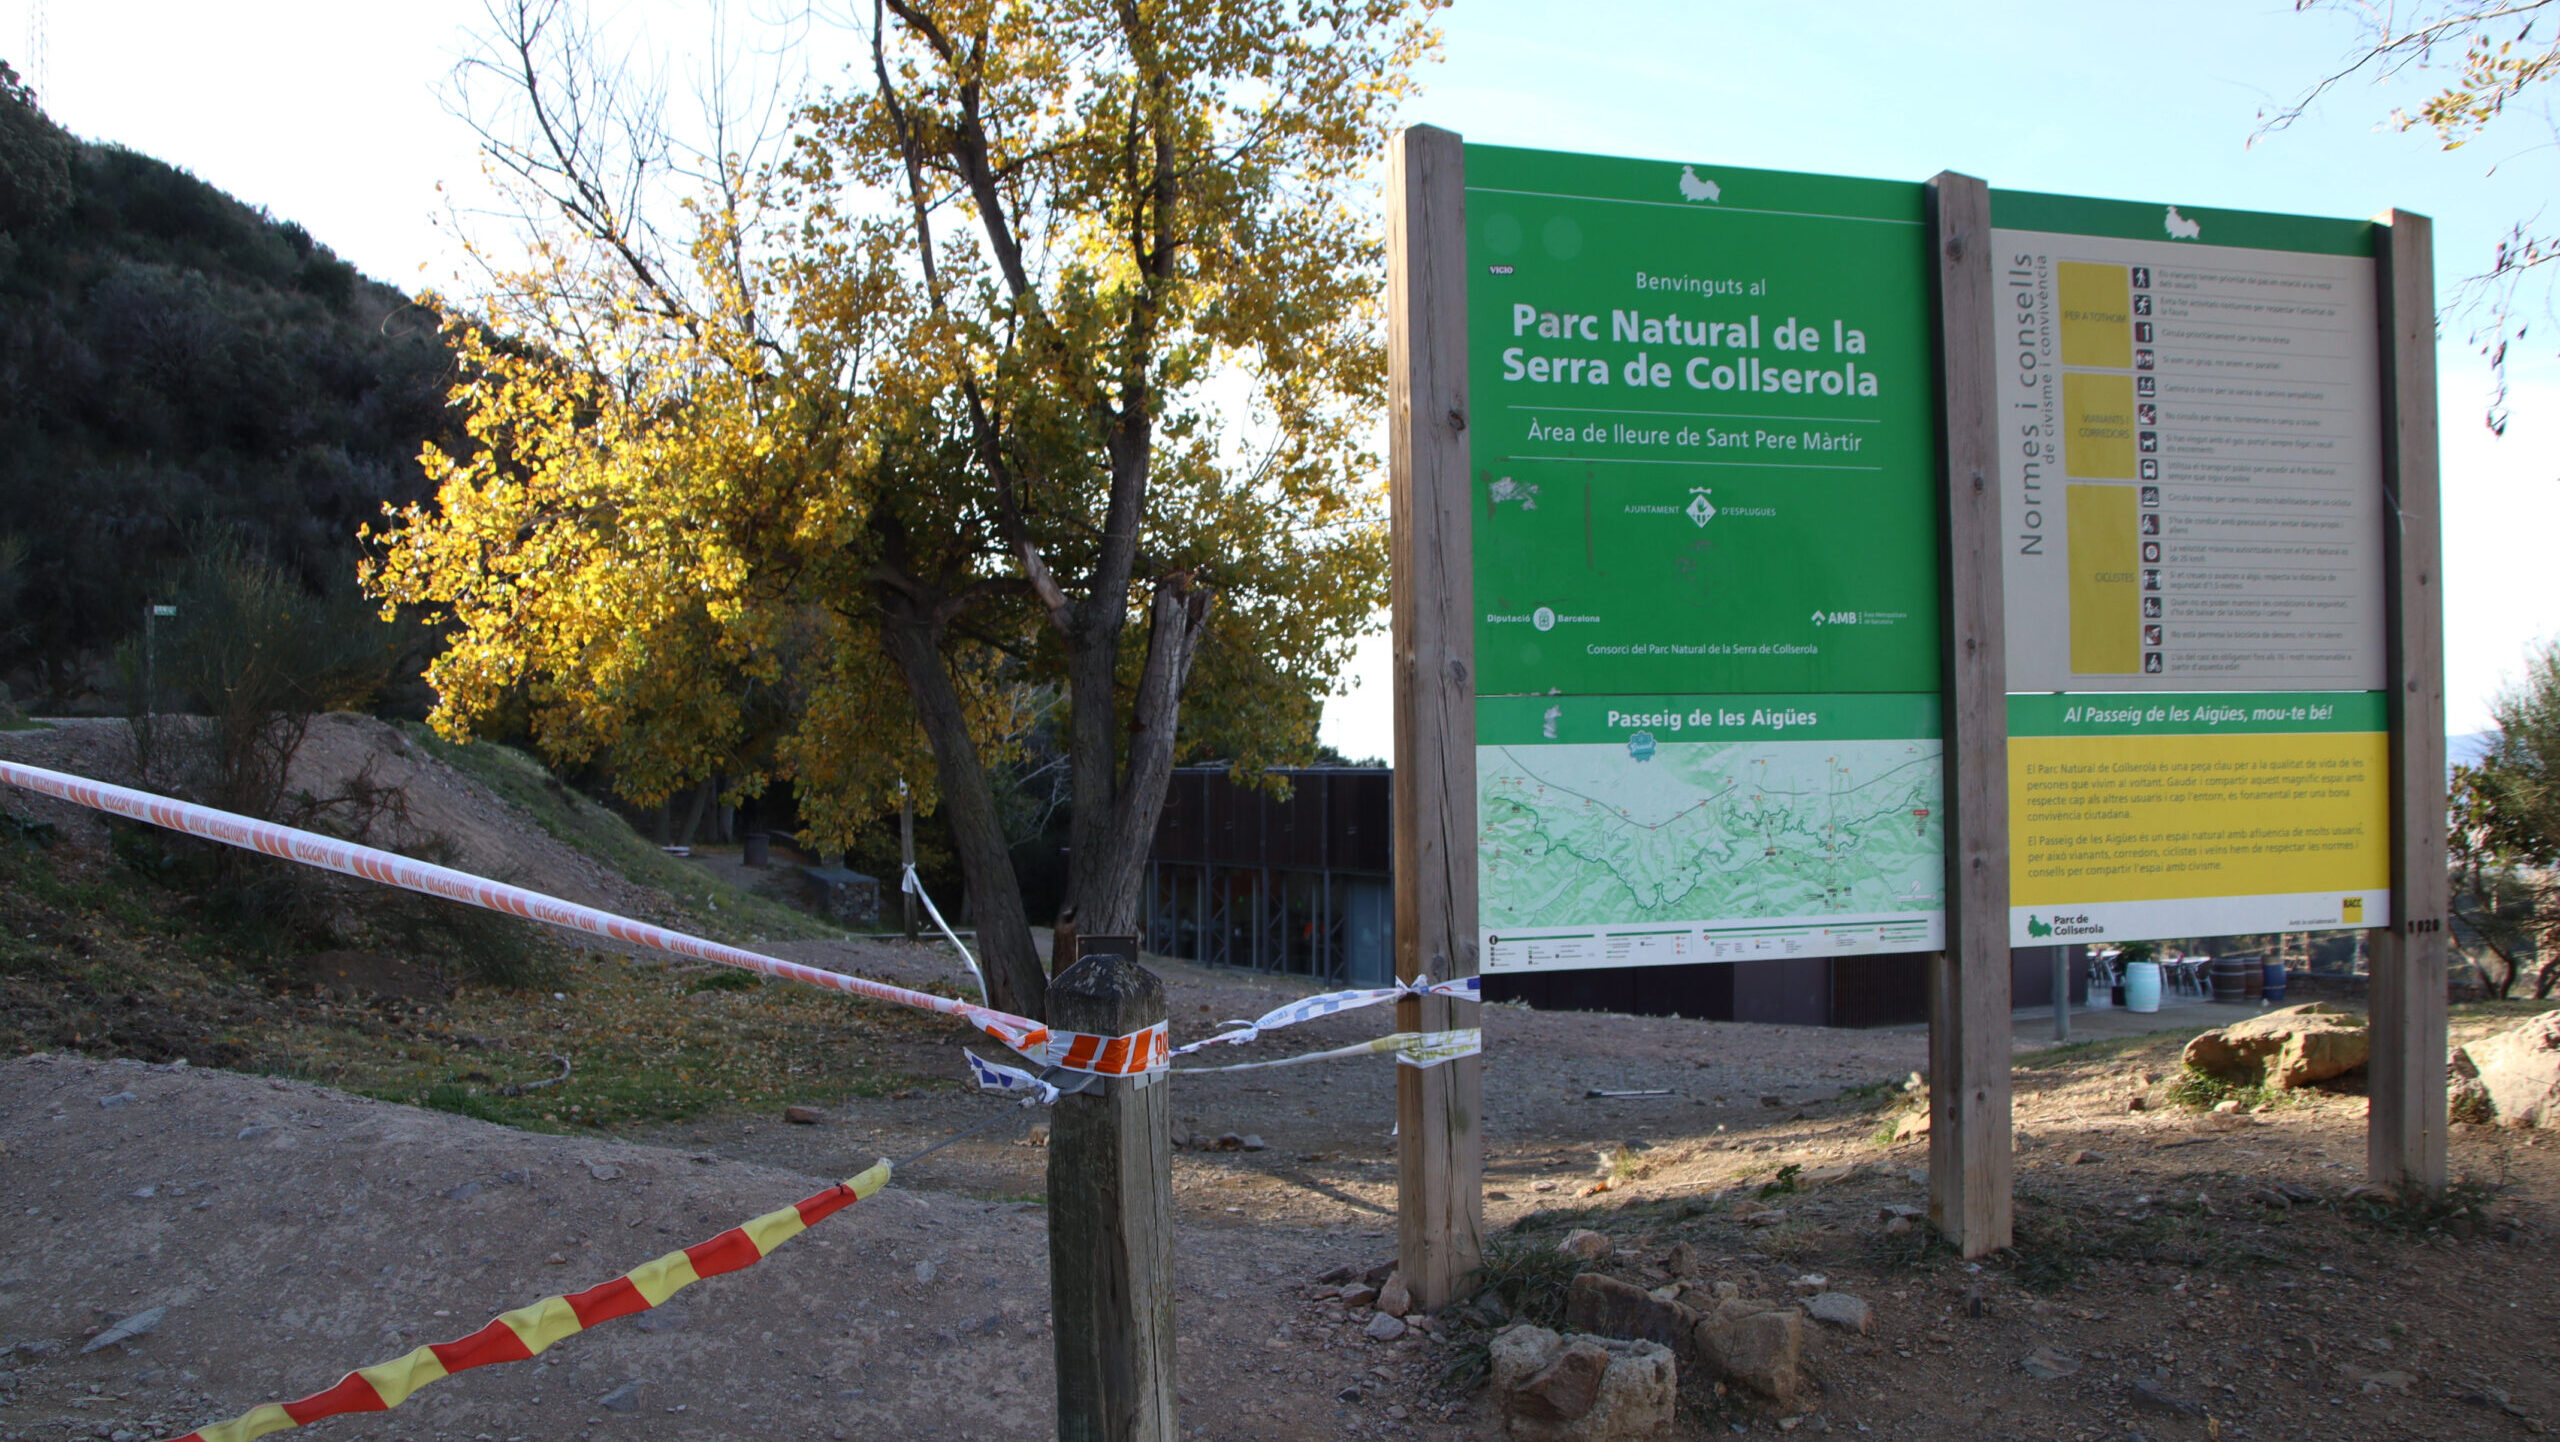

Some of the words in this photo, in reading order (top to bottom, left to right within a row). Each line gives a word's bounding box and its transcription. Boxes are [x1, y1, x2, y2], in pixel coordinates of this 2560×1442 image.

[1489, 265, 1514, 275] VICIO
[1636, 271, 1743, 297] Benvinguts
[1750, 279, 1766, 296] al
[2035, 255, 2052, 355] convivència
[1513, 304, 1598, 340] Parc
[1612, 309, 1759, 349] Natural
[1773, 318, 1820, 352] de
[1835, 320, 1866, 354] la
[2009, 253, 2037, 388] consells
[1502, 347, 1609, 385] Serra
[1624, 352, 1672, 388] de
[1686, 357, 1878, 396] Collserola
[2015, 402, 2038, 410] i
[2041, 374, 2055, 436] civisme
[1528, 417, 1575, 443] Àrea
[1582, 423, 1607, 442] de
[1613, 424, 1670, 444] lleure
[1676, 427, 1700, 446] de
[1706, 429, 1750, 448] Sant
[1756, 430, 1797, 449] Pere
[1803, 431, 1862, 451] Màrtir
[2042, 440, 2055, 465] de
[2020, 425, 2043, 555] Normes
[1624, 505, 1680, 514] AJUNTAMENT
[1722, 507, 1776, 517] D'ESPLUGUES
[1487, 613, 1530, 624] Diputació
[1557, 614, 1600, 622] Barcelona
[1828, 612, 1857, 624] AMB
[1587, 644, 1630, 654] Consorci
[1632, 644, 1647, 654] del
[1649, 644, 1669, 654] Parc
[1671, 644, 1706, 654] Natural
[1708, 644, 1720, 654] de
[1723, 644, 1731, 654] la
[1733, 644, 1757, 654] Serra
[1759, 644, 1771, 654] de
[1773, 644, 1818, 654] Collserola
[1608, 711, 1681, 731] Passeig
[1688, 710, 1712, 726] de
[1718, 709, 1745, 726] les
[1752, 708, 1817, 729] Aigües
[2064, 707, 2082, 723] Al
[2085, 707, 2143, 727] Passeig
[2146, 707, 2166, 722] de
[2168, 707, 2190, 721] les
[2193, 706, 2248, 725] Aigües,
[2252, 706, 2306, 720] mou-te
[2309, 706, 2335, 720] bé!
[2054, 916, 2074, 925] Parc
[2076, 914, 2089, 924] de
[2054, 924, 2104, 936] Collserola
